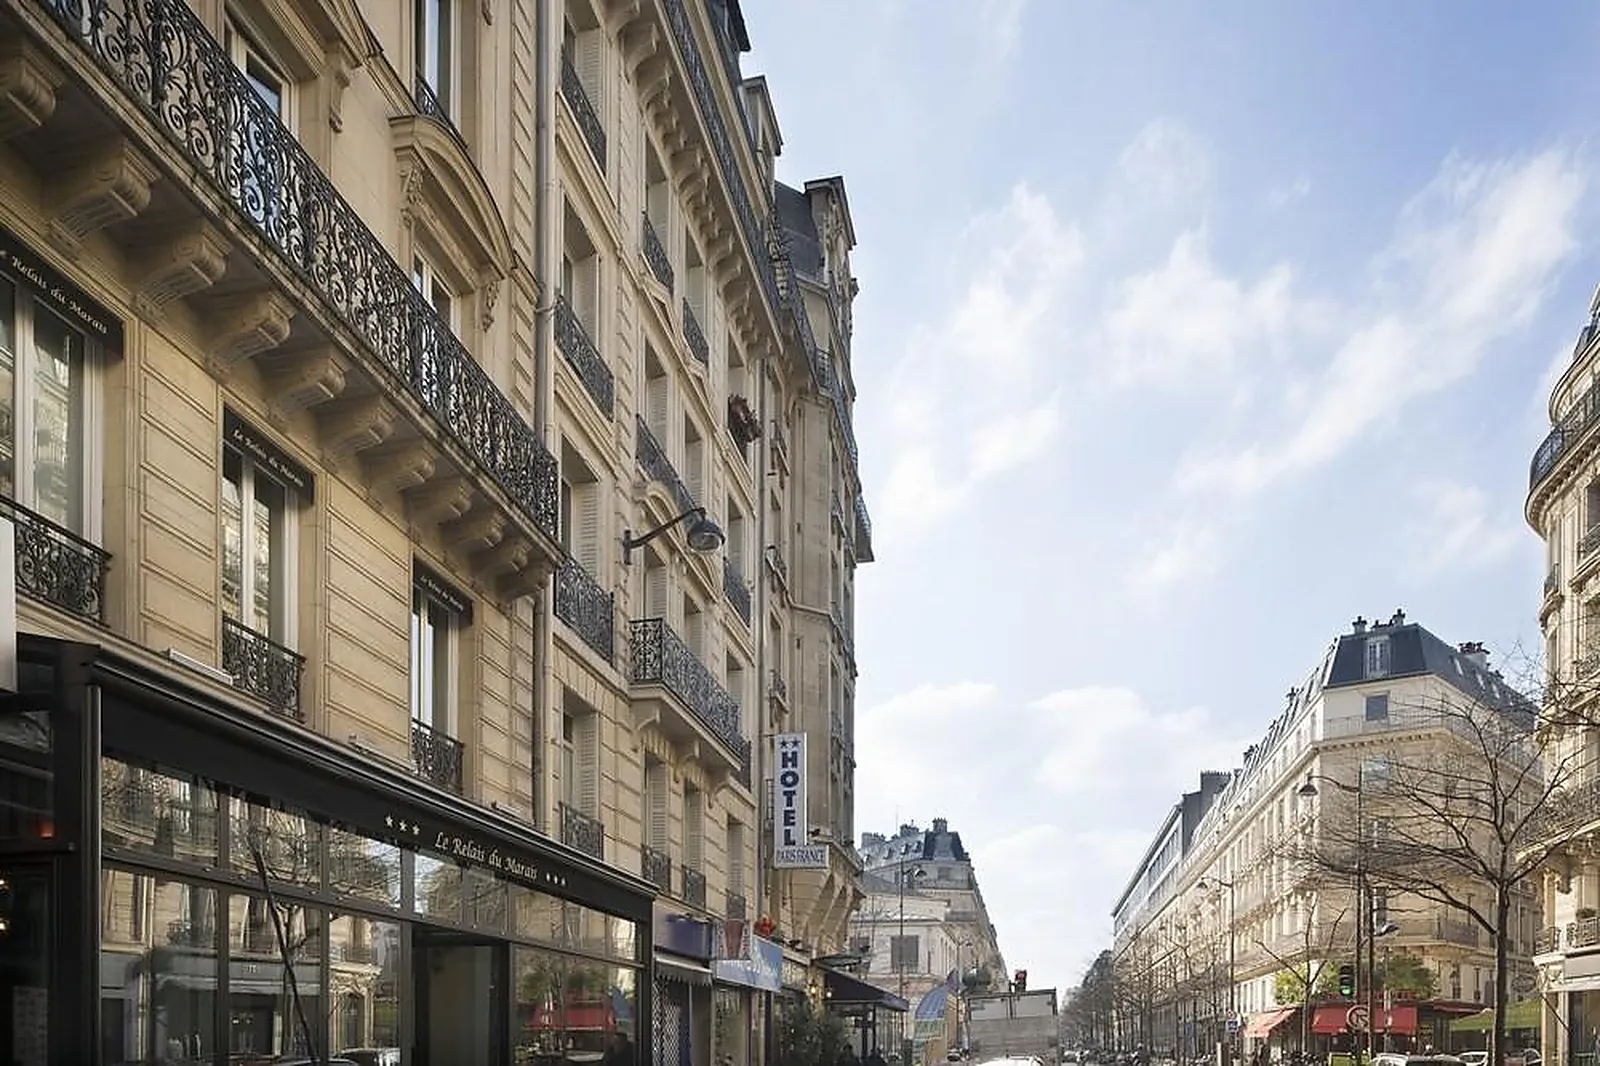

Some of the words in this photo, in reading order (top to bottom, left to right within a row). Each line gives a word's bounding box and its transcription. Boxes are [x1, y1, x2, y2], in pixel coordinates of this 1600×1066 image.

[780, 751, 799, 846] HOTEL
[434, 832, 448, 850] Le
[452, 838, 485, 862] Relais
[489, 848, 502, 868] du
[504, 857, 537, 880] Marais
